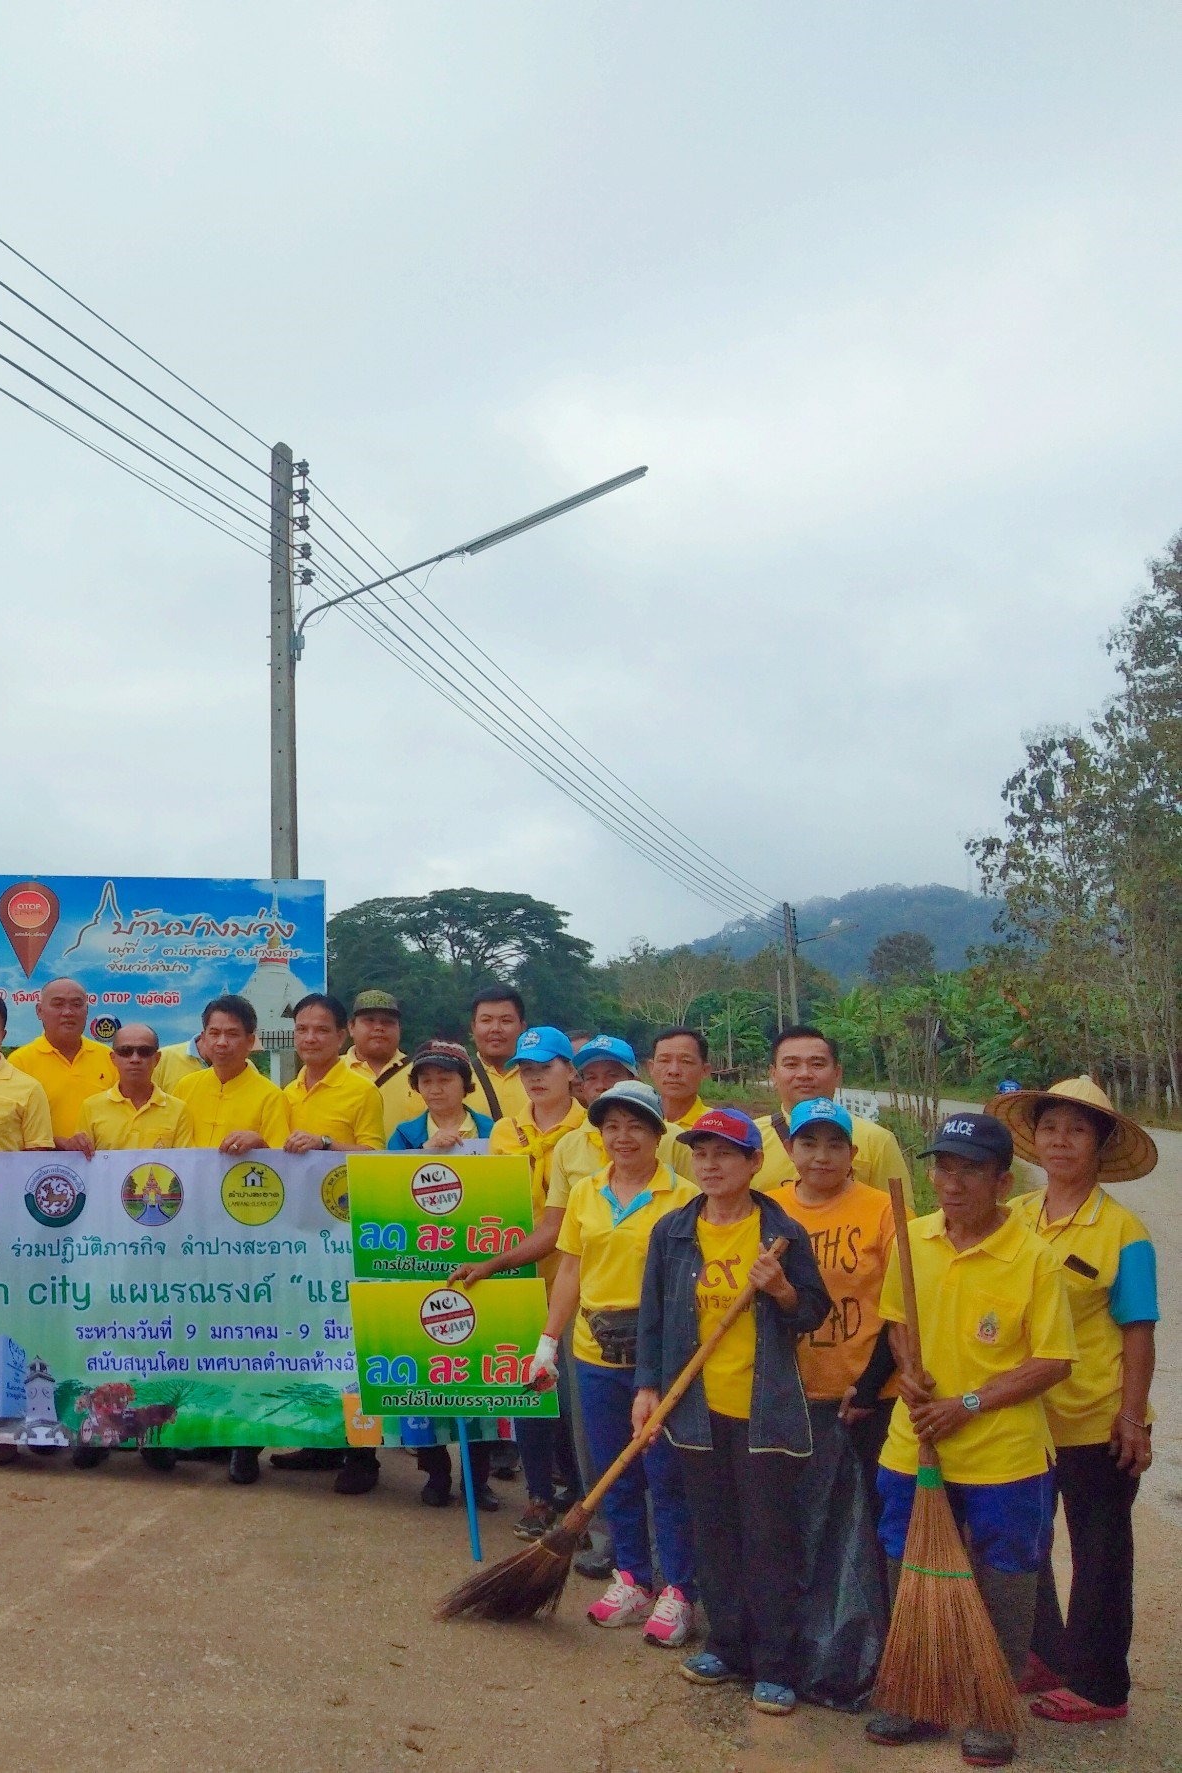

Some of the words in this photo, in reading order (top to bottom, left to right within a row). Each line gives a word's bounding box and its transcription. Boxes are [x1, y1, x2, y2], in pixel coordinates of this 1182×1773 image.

[112, 908, 295, 938] บ้านปางม่วง
[107, 959, 189, 972] จังหวัดลำปาง
[103, 992, 130, 1004] OTOP
[136, 991, 180, 1006] นวัตวิถี
[701, 1119, 724, 1128] HOYA
[942, 1120, 975, 1136] POLICE
[11, 1235, 167, 1263] ร่วมปฏิบัติภารกิจ
[181, 1234, 307, 1256] ลำปางสะอาด
[319, 1230, 352, 1257] ในเ
[359, 1223, 407, 1250] ลด
[417, 1224, 456, 1251] ละ
[467, 1216, 526, 1253] เลิก
[28, 1275, 91, 1311] city
[110, 1272, 276, 1304] แผนรณรงค์
[75, 1315, 173, 1340] ระหว่างวันที่
[186, 1324, 197, 1340] 9
[211, 1324, 278, 1340] มกราคม
[299, 1324, 310, 1340] 9
[86, 1351, 189, 1378] สนับสนุนโดย
[197, 1350, 357, 1372] เทศบาลตำบลห้างฉั
[366, 1355, 417, 1385] ลด
[428, 1355, 469, 1385] ละ
[382, 1390, 540, 1411] การใช้โฟมบรรจุอาหาร
